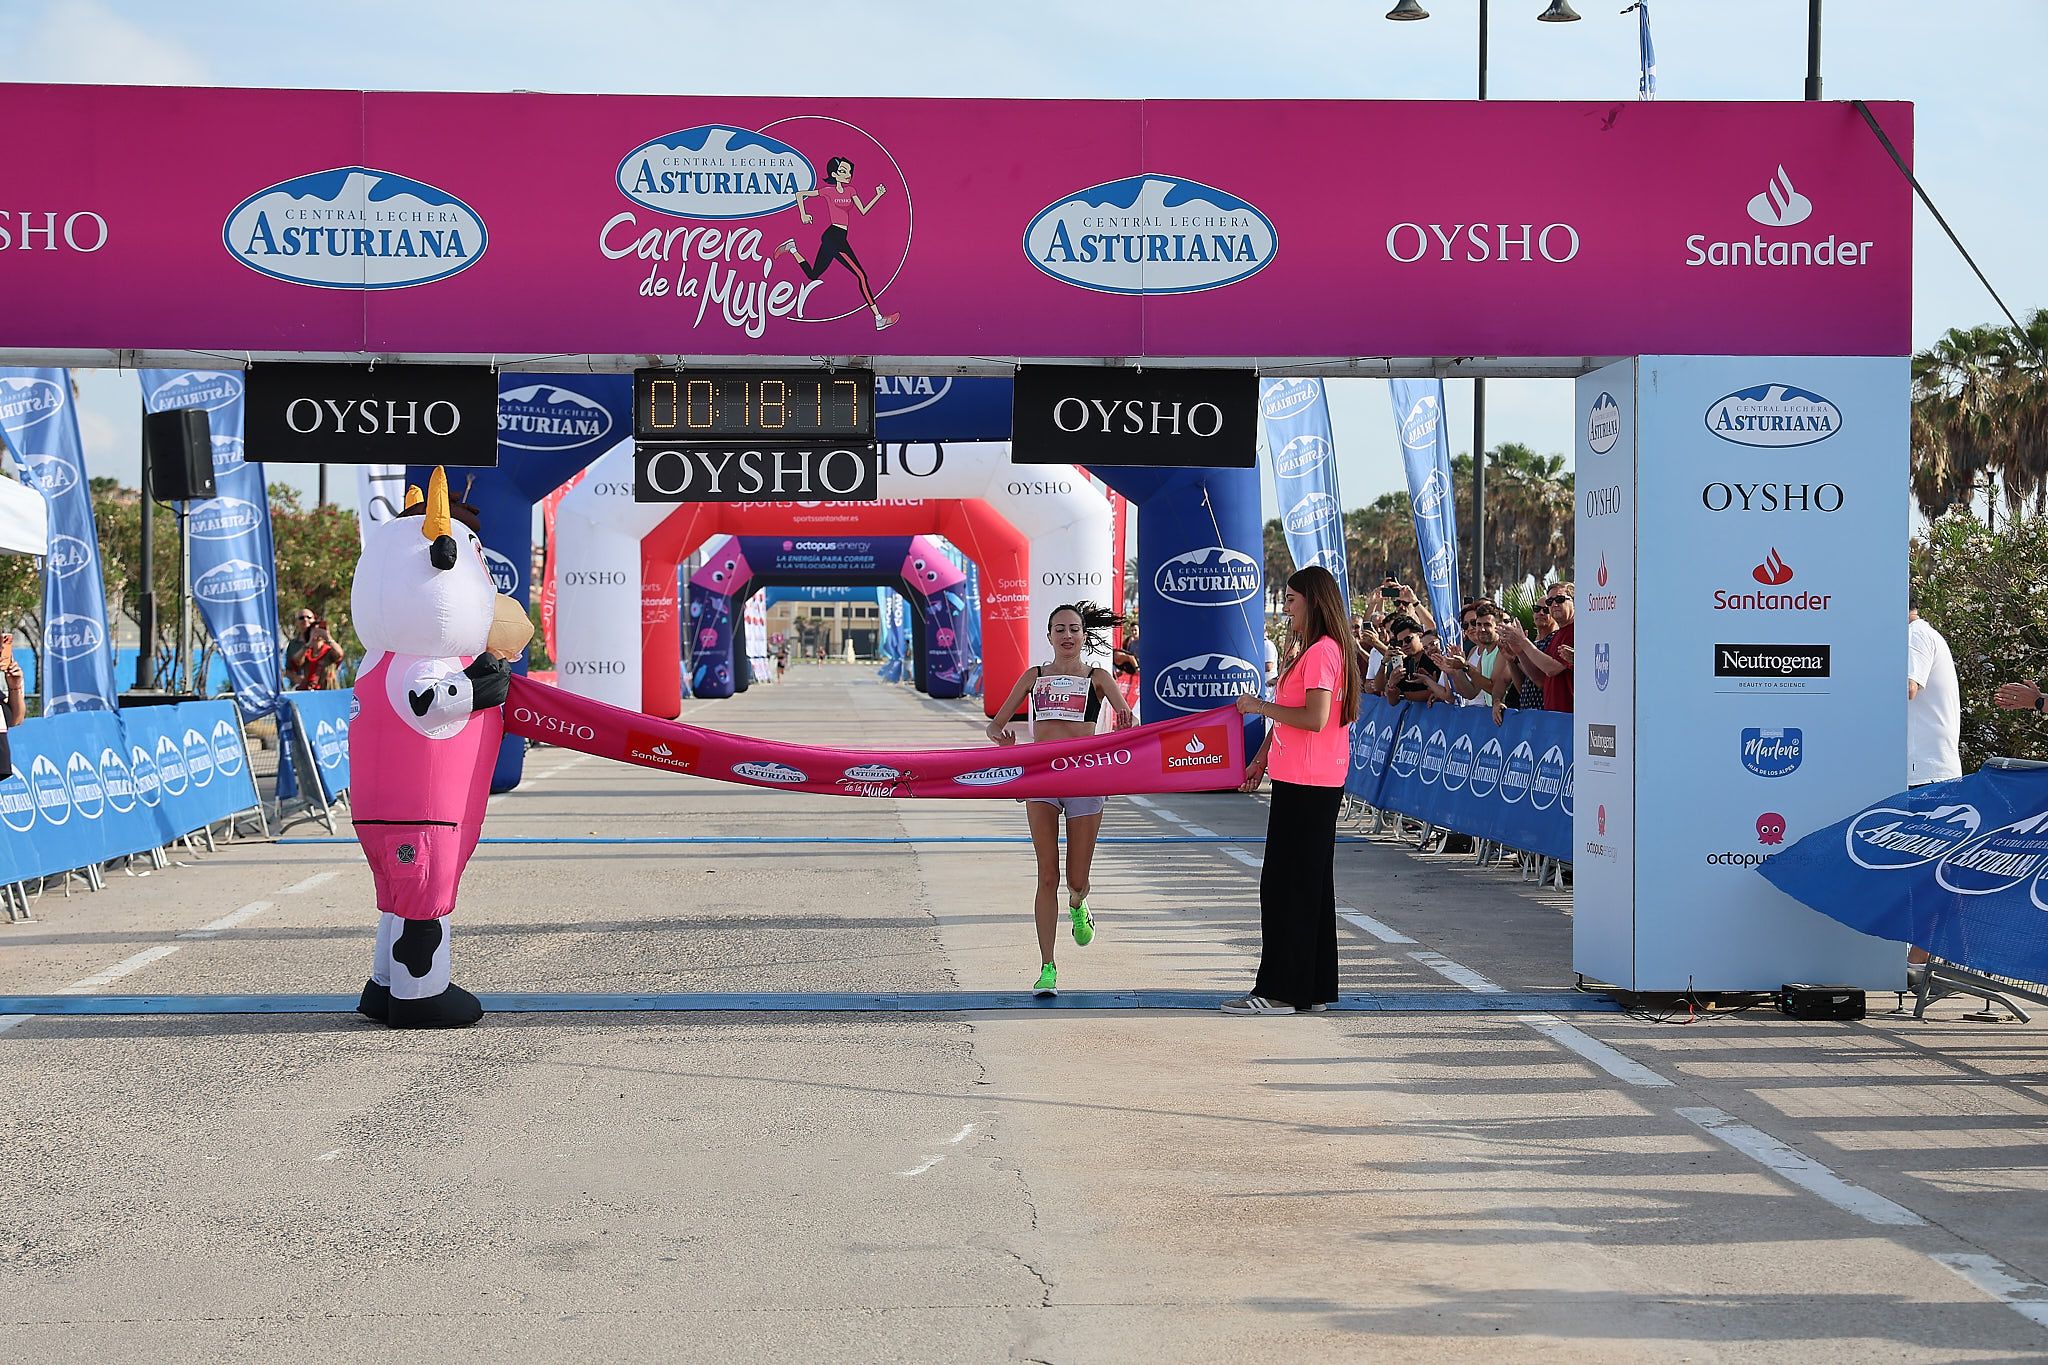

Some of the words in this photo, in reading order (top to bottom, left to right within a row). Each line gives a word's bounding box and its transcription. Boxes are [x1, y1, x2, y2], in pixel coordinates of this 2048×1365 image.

[663, 157, 725, 167] CENTRAL
[731, 158, 794, 167] LECHERA
[631, 158, 799, 195] ASTURIANA
[285, 209, 367, 221] CENTRAL
[376, 211, 459, 223] LECHERA
[1083, 217, 1162, 227] CENTRAL
[1170, 217, 1250, 227] LECHERA
[244, 210, 468, 258] ASTURIANA
[599, 211, 763, 261] Carrera
[1043, 219, 1259, 263] ASTURIANA
[1385, 222, 1581, 264] OYSHO
[1685, 232, 1874, 267] Santander
[639, 264, 670, 297] de
[676, 263, 698, 298] la
[693, 257, 825, 339] Mujer
[500, 404, 547, 414] CENTRAL
[551, 408, 599, 418] LECHERA
[650, 379, 858, 429] 00:18:17
[285, 397, 461, 436] OYSHO
[498, 414, 600, 436] STURIANA
[1053, 396, 1224, 437] OYSHO
[1714, 406, 1833, 432] ASTURIANA
[646, 450, 866, 495] OYSHO
[594, 482, 635, 497] OYS
[1007, 482, 1072, 496] OYSHO
[1702, 482, 1844, 512] OYSHO
[1586, 485, 1620, 519] OYSHO
[795, 541, 836, 552] octopus
[565, 571, 626, 586] OYSHO
[998, 578, 1028, 590] Sports
[1042, 572, 1102, 586] OYSHO
[1161, 569, 1256, 592] ASTURIANA
[996, 593, 1029, 603] Santan
[1714, 590, 1832, 611] Santander
[565, 661, 625, 675] OYSHO
[1722, 650, 1823, 674] Neutrogena
[1161, 675, 1257, 698] ASTURIANA
[1049, 694, 1070, 702] 016
[513, 707, 595, 741] OYSHO
[631, 750, 690, 768] Santander
[1051, 749, 1132, 771] OYSHO
[1168, 754, 1223, 768] Santander
[1744, 737, 1800, 765] Marlene
[737, 765, 801, 782] ASTURIANA
[847, 767, 897, 778] ASTURIANA
[1747, 762, 1759, 773] HIJA
[1778, 764, 1795, 775] ALPES
[1855, 821, 1952, 858] ASTURIANA
[1706, 851, 1776, 869] octopu
[1946, 837, 2041, 878] ASTURIANA
